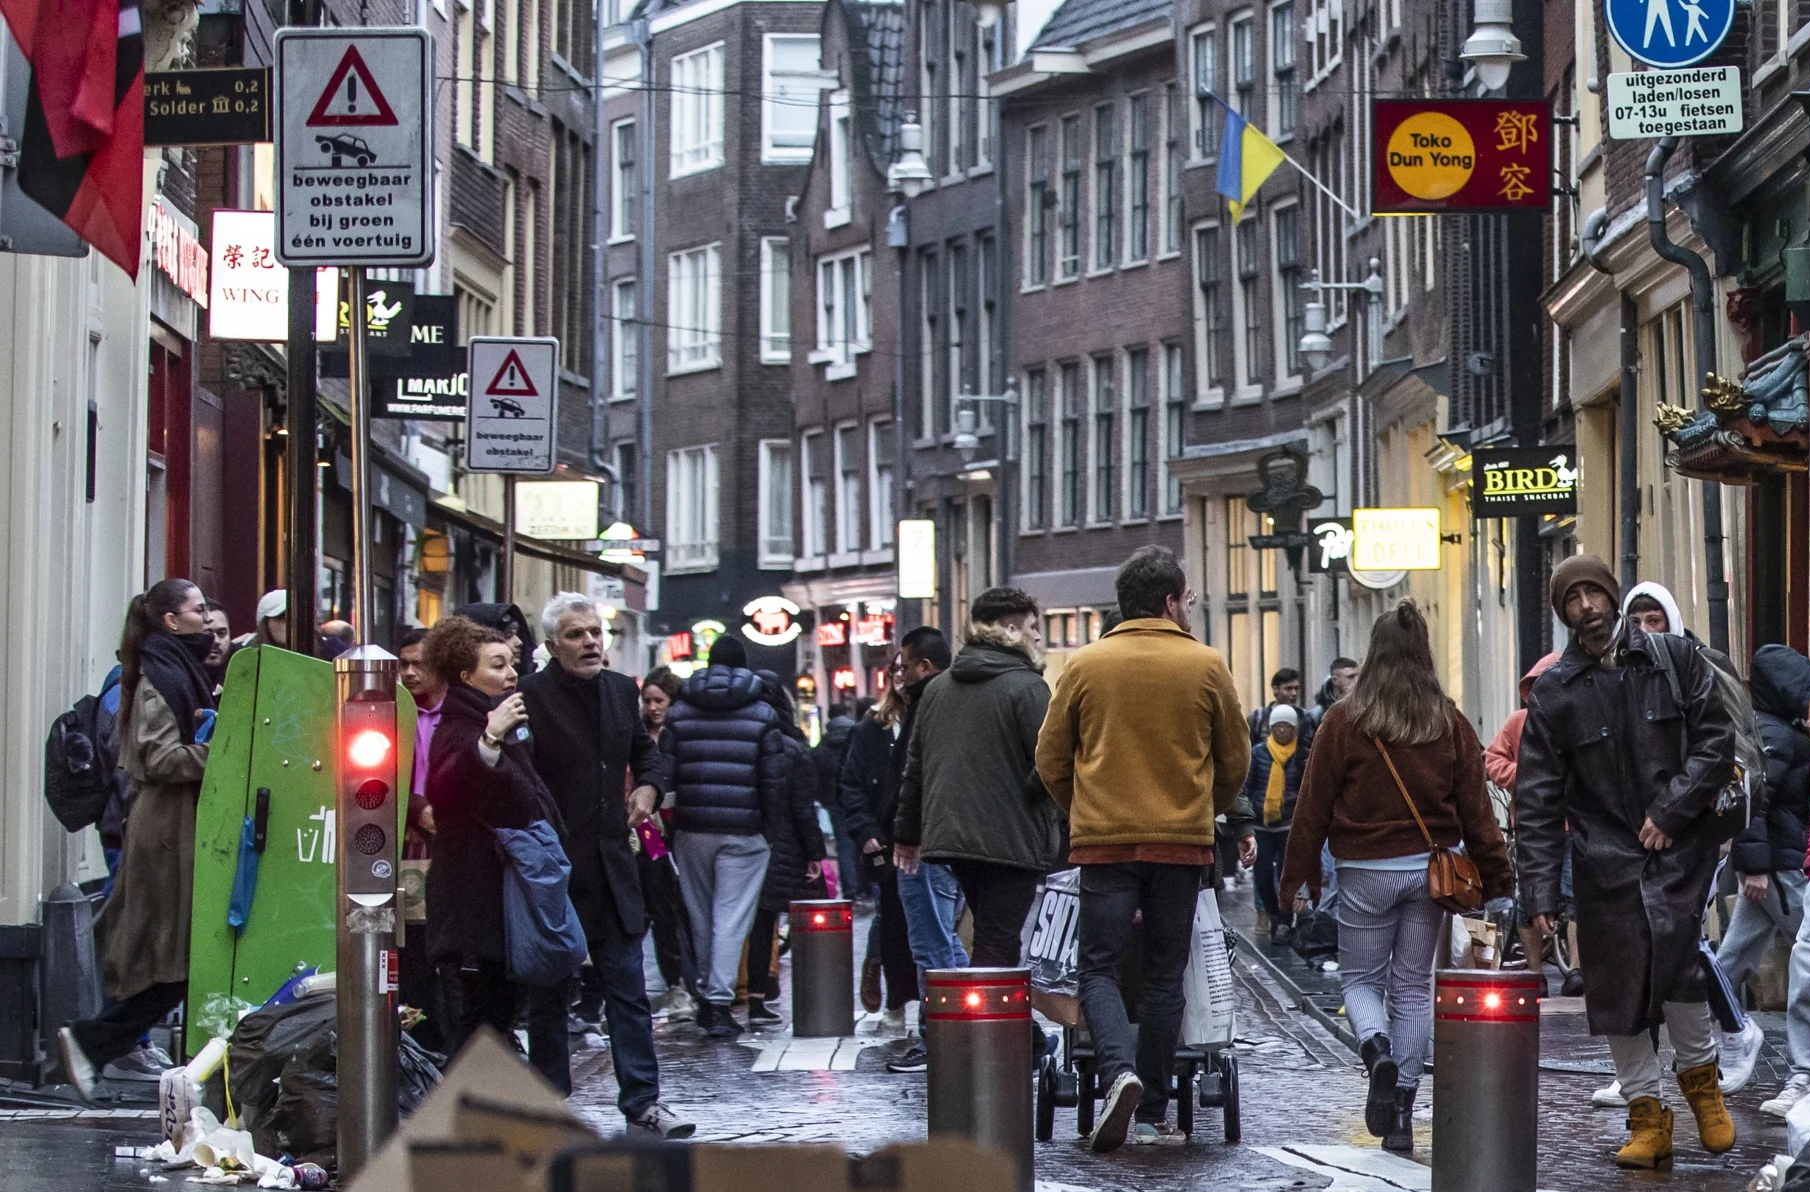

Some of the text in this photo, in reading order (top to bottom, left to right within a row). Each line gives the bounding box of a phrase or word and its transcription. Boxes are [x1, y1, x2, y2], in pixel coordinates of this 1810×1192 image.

[1625, 68, 1727, 89] uitgezonderd
[144, 80, 258, 96] erk 0,2
[1632, 87, 1720, 104] laden/losen
[150, 100, 259, 116] Solder 0,2
[1615, 103, 1734, 120] 07-13u fietsen
[1638, 118, 1727, 136] toegestaan
[1410, 133, 1452, 148] Toko
[1389, 152, 1473, 169] Dun Yong
[292, 173, 412, 189] beweegbaar
[310, 193, 393, 207] obstakel
[309, 214, 394, 230] bij groen
[291, 233, 412, 249] één voertuig
[222, 287, 279, 304] WING
[475, 431, 544, 442] beweegbaar
[485, 447, 534, 456] obstakel
[1484, 467, 1558, 492] BIRD
[1523, 492, 1570, 501] SNACKBAR
[1373, 541, 1424, 563] DELI
